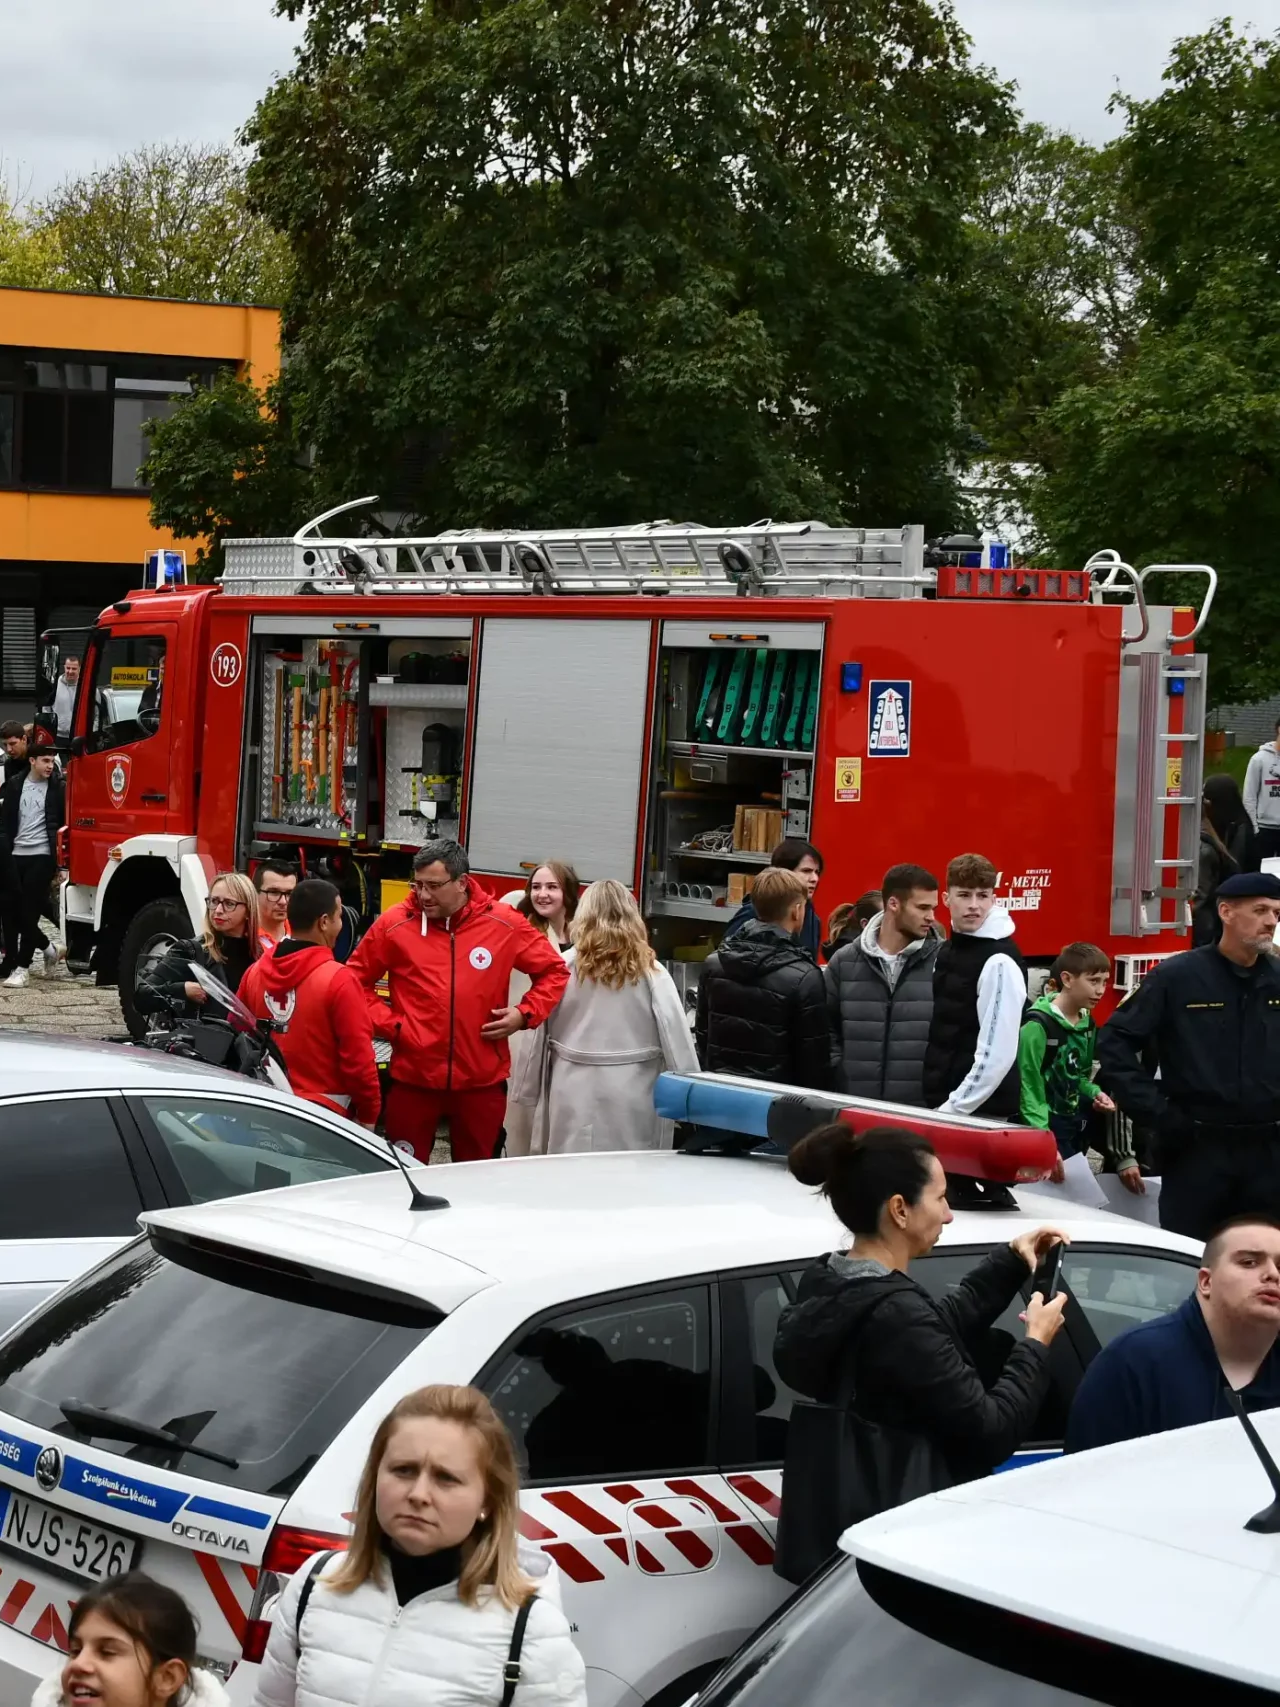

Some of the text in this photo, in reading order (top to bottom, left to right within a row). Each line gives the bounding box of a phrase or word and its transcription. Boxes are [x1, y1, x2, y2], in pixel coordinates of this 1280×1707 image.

[148, 670, 157, 681] L
[217, 655, 236, 679] 193
[1011, 875, 1052, 888] METAL
[994, 888, 1041, 911] enbauer
[81, 1469, 120, 1492] Szolgálunk
[120, 1484, 129, 1495] és
[6, 1499, 126, 1577] NJS-526
[171, 1521, 250, 1554] OCTAVIA
